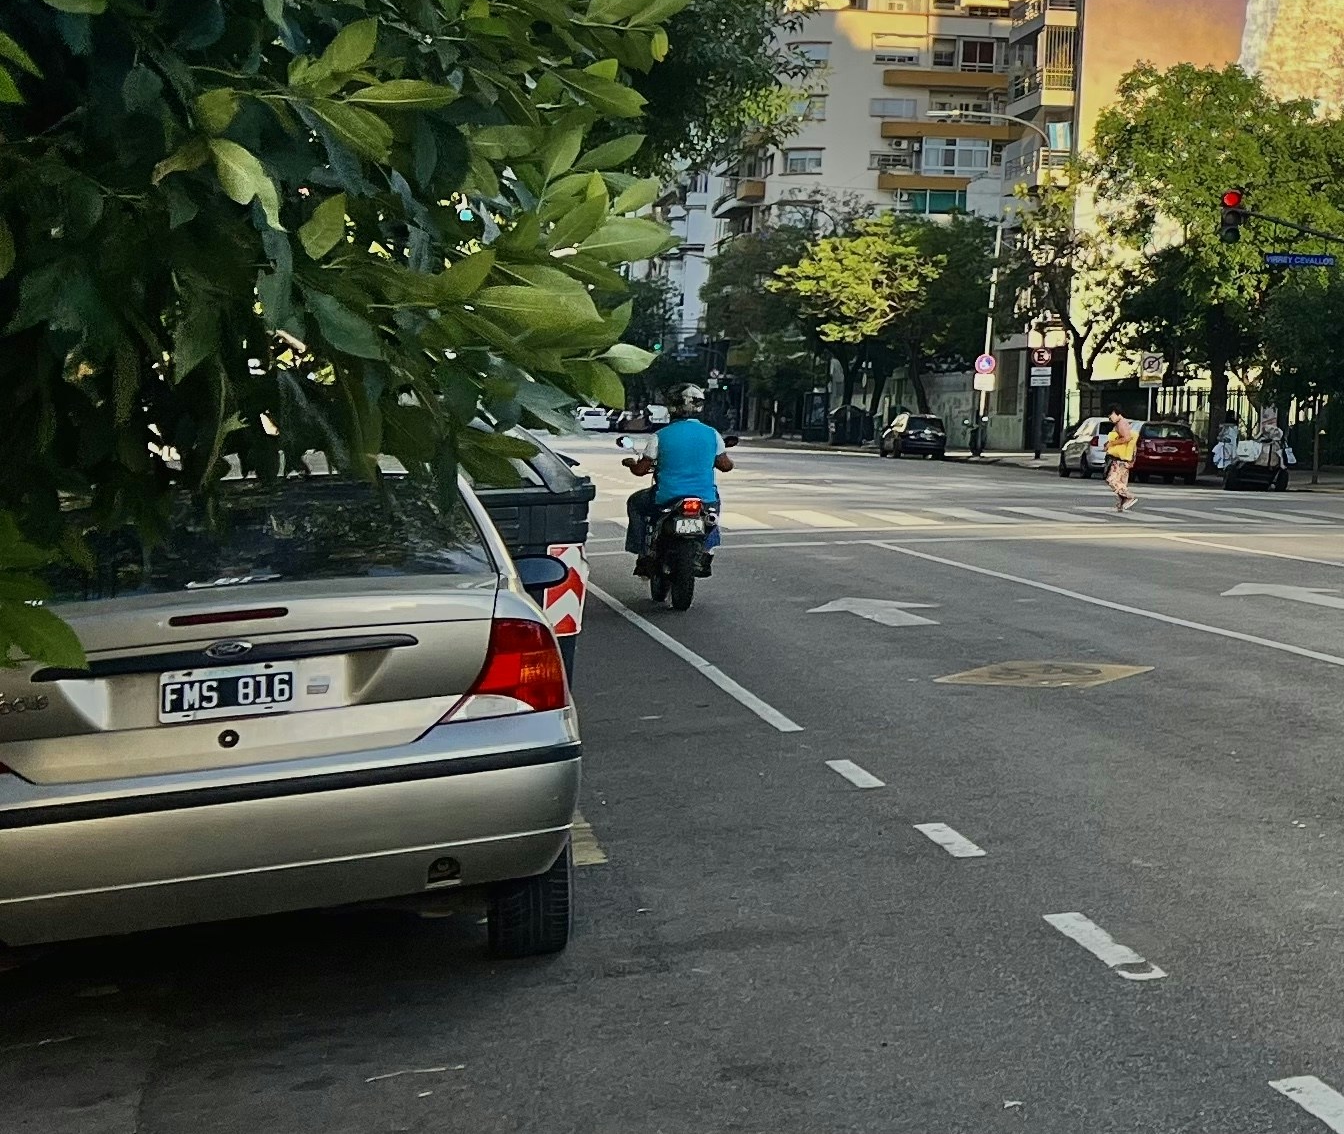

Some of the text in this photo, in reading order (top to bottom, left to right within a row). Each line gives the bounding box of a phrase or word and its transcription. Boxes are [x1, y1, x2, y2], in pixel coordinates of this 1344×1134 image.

[1294, 256, 1334, 265] CEVALLOS
[164, 674, 290, 712] FMS 816
